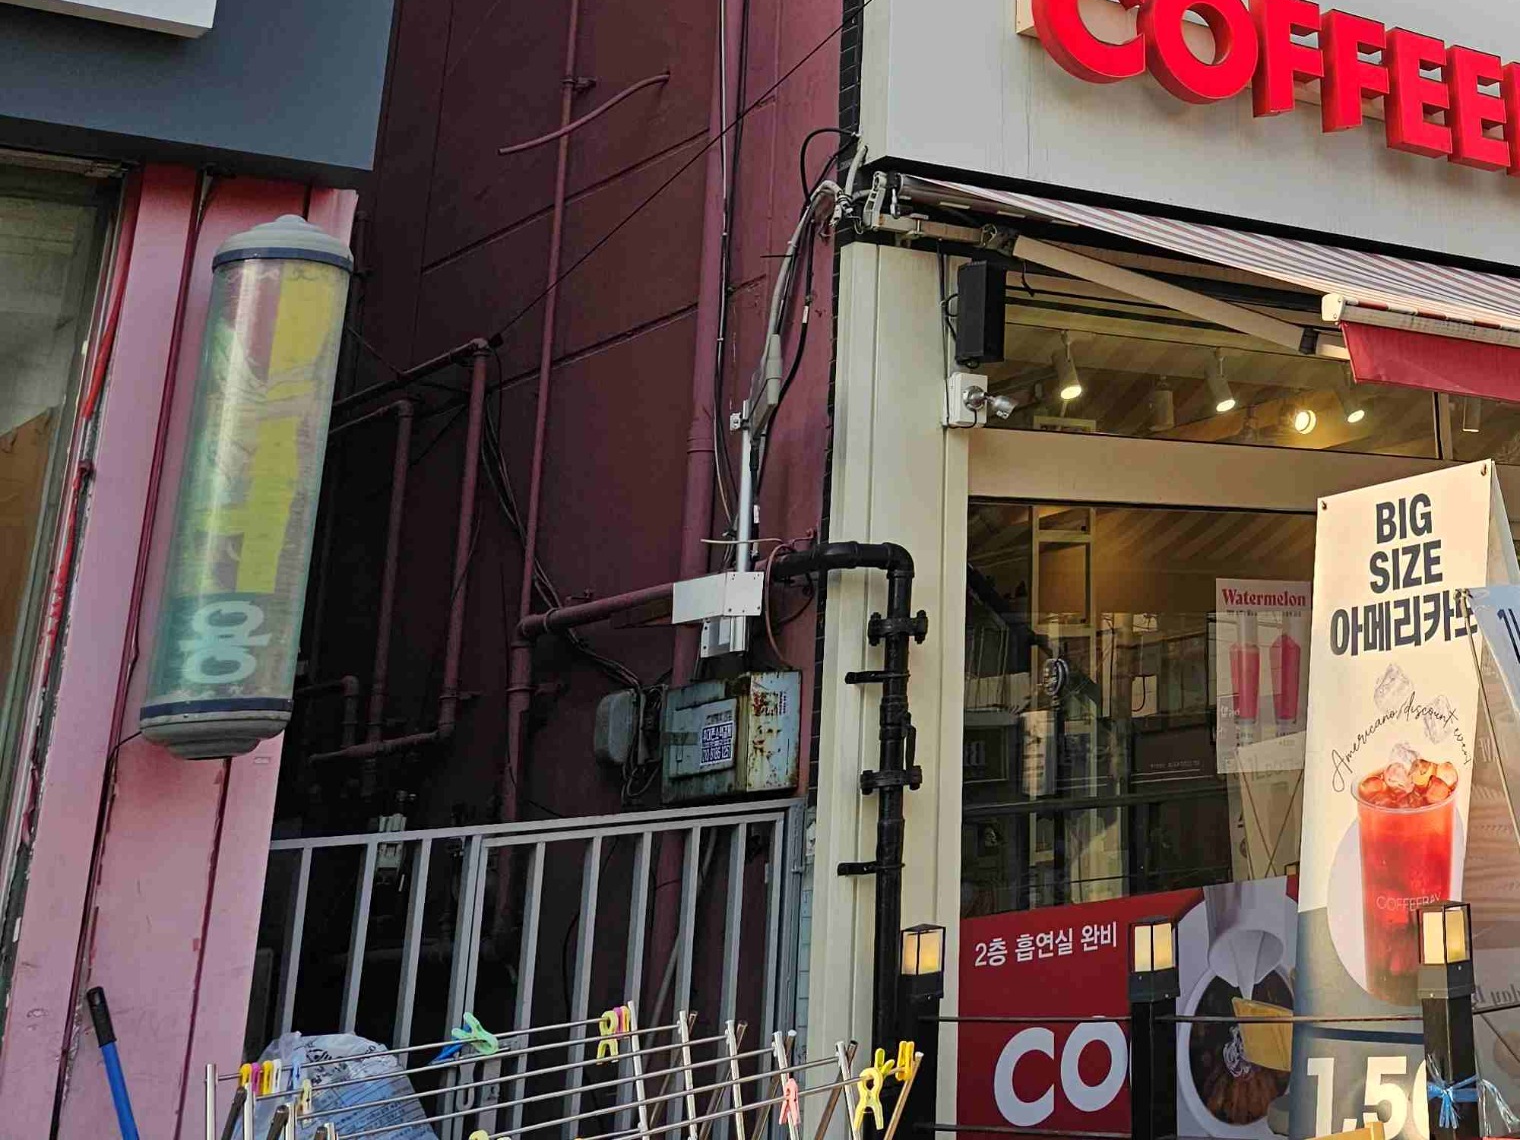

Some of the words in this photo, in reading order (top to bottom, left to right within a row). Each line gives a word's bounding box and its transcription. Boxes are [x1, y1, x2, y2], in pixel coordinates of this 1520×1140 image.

[1375, 492, 1433, 545] BIG
[1368, 539, 1444, 595] SIZE
[1222, 588, 1307, 607] Watermelon
[975, 937, 1007, 968] 2층
[1015, 927, 1074, 962] 흡연실
[1081, 921, 1118, 950] 완비
